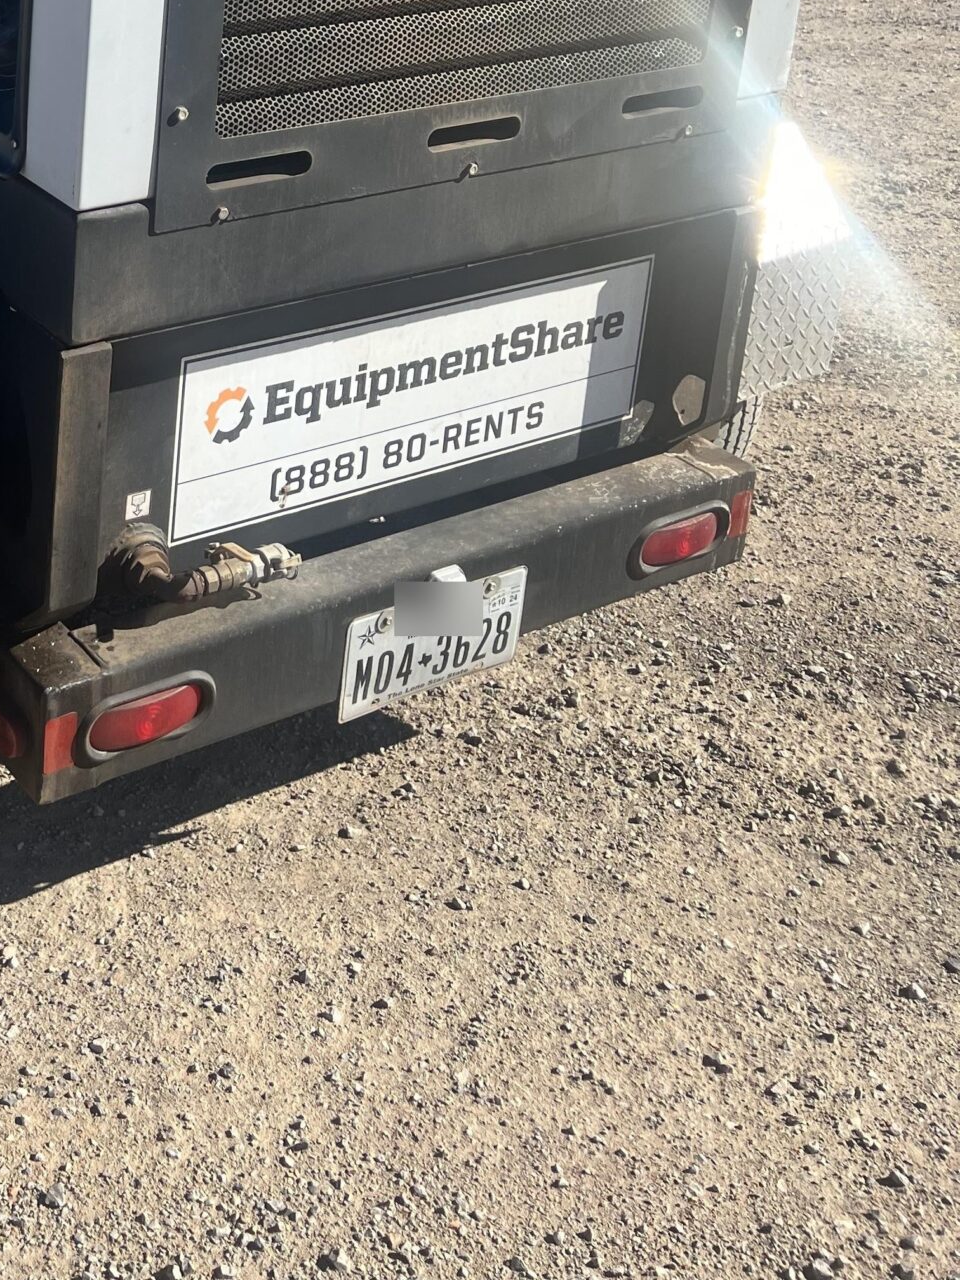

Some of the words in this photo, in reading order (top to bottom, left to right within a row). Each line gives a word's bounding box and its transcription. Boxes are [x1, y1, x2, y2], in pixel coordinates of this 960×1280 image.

[262, 309, 625, 425] EquipmentShare
[269, 445, 369, 502] (888)
[382, 400, 545, 470] 80-RENTS
